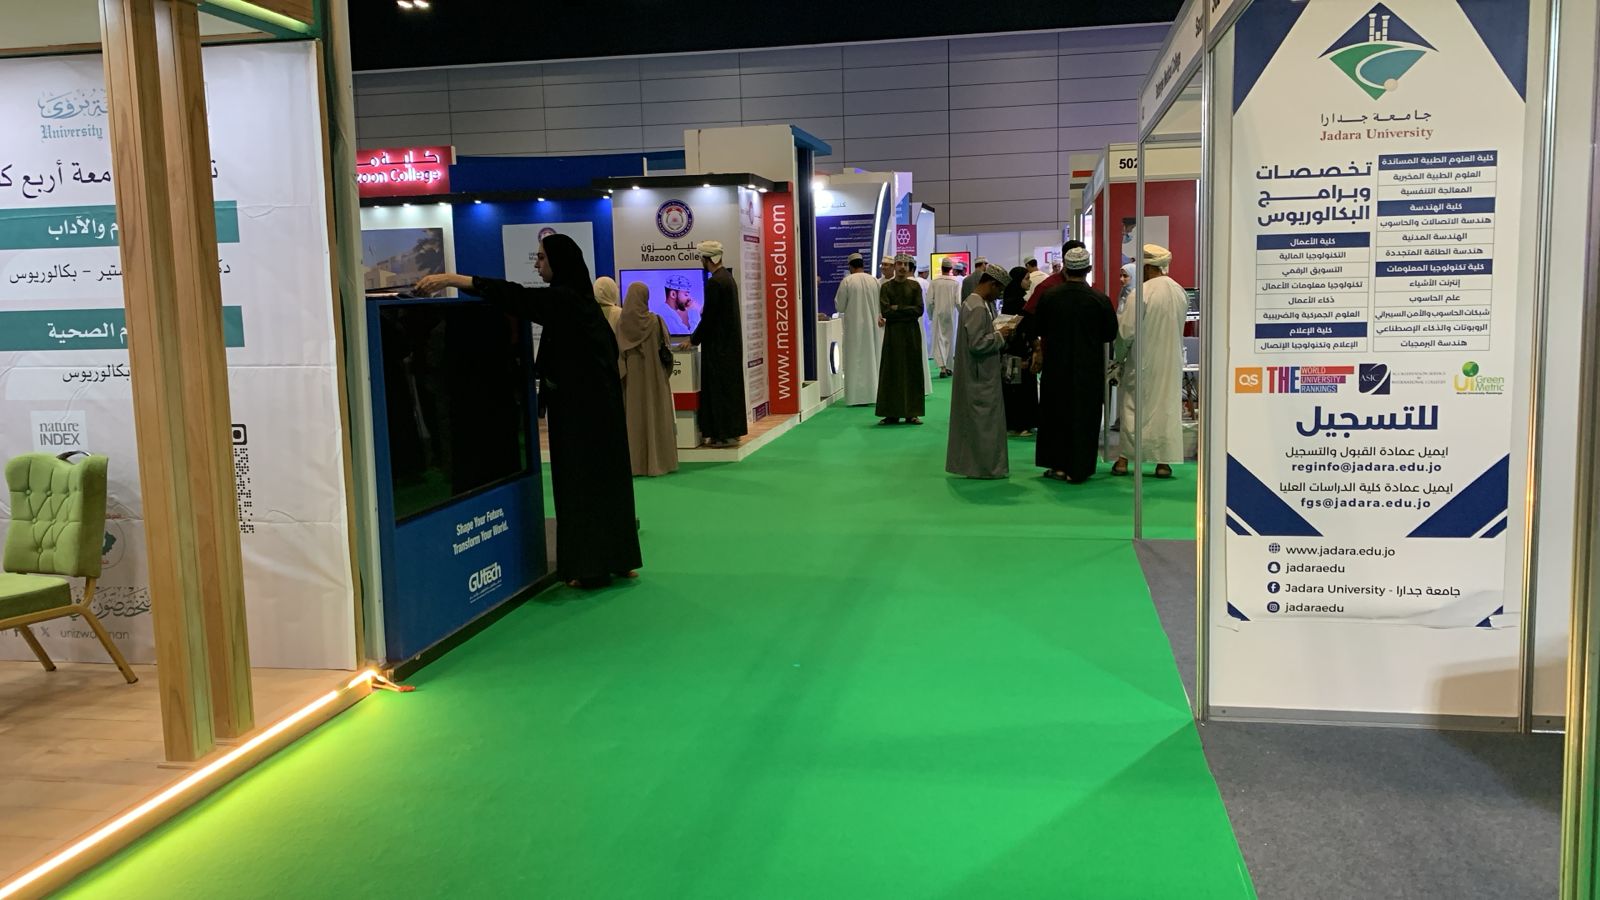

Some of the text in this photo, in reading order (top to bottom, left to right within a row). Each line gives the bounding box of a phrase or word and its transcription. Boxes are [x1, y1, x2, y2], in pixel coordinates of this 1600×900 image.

[1320, 110, 1432, 127] جامعة جدارا
[40, 124, 103, 140] University
[1320, 127, 1434, 141] Jadara University
[1382, 157, 1419, 166] المساندة
[1420, 156, 1446, 165] الطبية
[1449, 155, 1476, 166] العلوم
[72, 161, 111, 184] معة
[356, 168, 441, 184] zoon College
[1256, 161, 1372, 180] تخصصات
[22, 159, 62, 199] أربع
[1393, 171, 1481, 182] العلوم الطبية المخبرية
[1258, 184, 1371, 208] وبرامج
[1400, 186, 1472, 196] المعالجة التنفسية
[1410, 203, 1462, 212] كلية الهندسة
[1258, 205, 1370, 226] البكالوريوس
[48, 216, 106, 241] والآداب
[1380, 219, 1419, 228] والحاسوب
[1290, 238, 1336, 246] كلية الأعمال
[1402, 233, 1467, 242] الهندسة المدنية
[640, 242, 698, 253] لية مزون
[641, 252, 700, 262] Mazoon Colle
[1280, 252, 1346, 261] التكنولوجيا المالية
[1386, 249, 1422, 258] المتجددة
[9, 264, 77, 283] بكالوريوس
[1282, 266, 1342, 277] التسويق الرقمي
[1386, 264, 1484, 273] كلية تكنولوجيا المعلومات
[1262, 282, 1289, 291] الأعمال
[1328, 281, 1363, 289] تكنولوجيا
[1410, 279, 1460, 288] إنترنت الأشياء
[770, 204, 790, 400] www.mazcol.edu.om
[1288, 297, 1315, 305] الأعمال
[1409, 295, 1460, 303] علم الحاسوب
[1263, 312, 1299, 320] والضريبية
[1335, 311, 1360, 320] العلوم
[47, 322, 115, 344] الصحية
[1289, 327, 1314, 336] الإعلام
[1376, 325, 1420, 334] الإصطناعي
[1453, 324, 1488, 332] الروبوتات
[1333, 341, 1358, 350] الإعلام
[62, 364, 130, 382] بكالوريوس
[1361, 374, 1378, 382] ASIC
[1238, 374, 1259, 387] QS
[1266, 366, 1300, 393] THE
[1476, 376, 1504, 384] Green
[40, 422, 79, 432] nature
[1296, 405, 1438, 438] للتسجيل
[40, 433, 80, 446] INDEX
[1285, 446, 1448, 458] ايميل عمادة القبول والتسجيل
[1292, 462, 1442, 473] reginfo@jadara.edu.jo
[1279, 482, 1453, 494] ايميل عمادة كلية الدراسات العليا
[1301, 498, 1431, 510] fgs@jadara.edu.jo
[456, 508, 504, 536] Shape Your Future,
[453, 520, 509, 555] Transform Your World.
[1286, 546, 1396, 558] www.jadara.edu.jo
[1286, 562, 1345, 574] jadaraedu
[468, 562, 502, 592] GUtech
[1285, 584, 1324, 594] Jadara
[1328, 584, 1386, 597] University
[1396, 586, 1422, 597] جدارا
[1426, 587, 1460, 598] جامعة
[1285, 602, 1344, 613] jadaraedu
